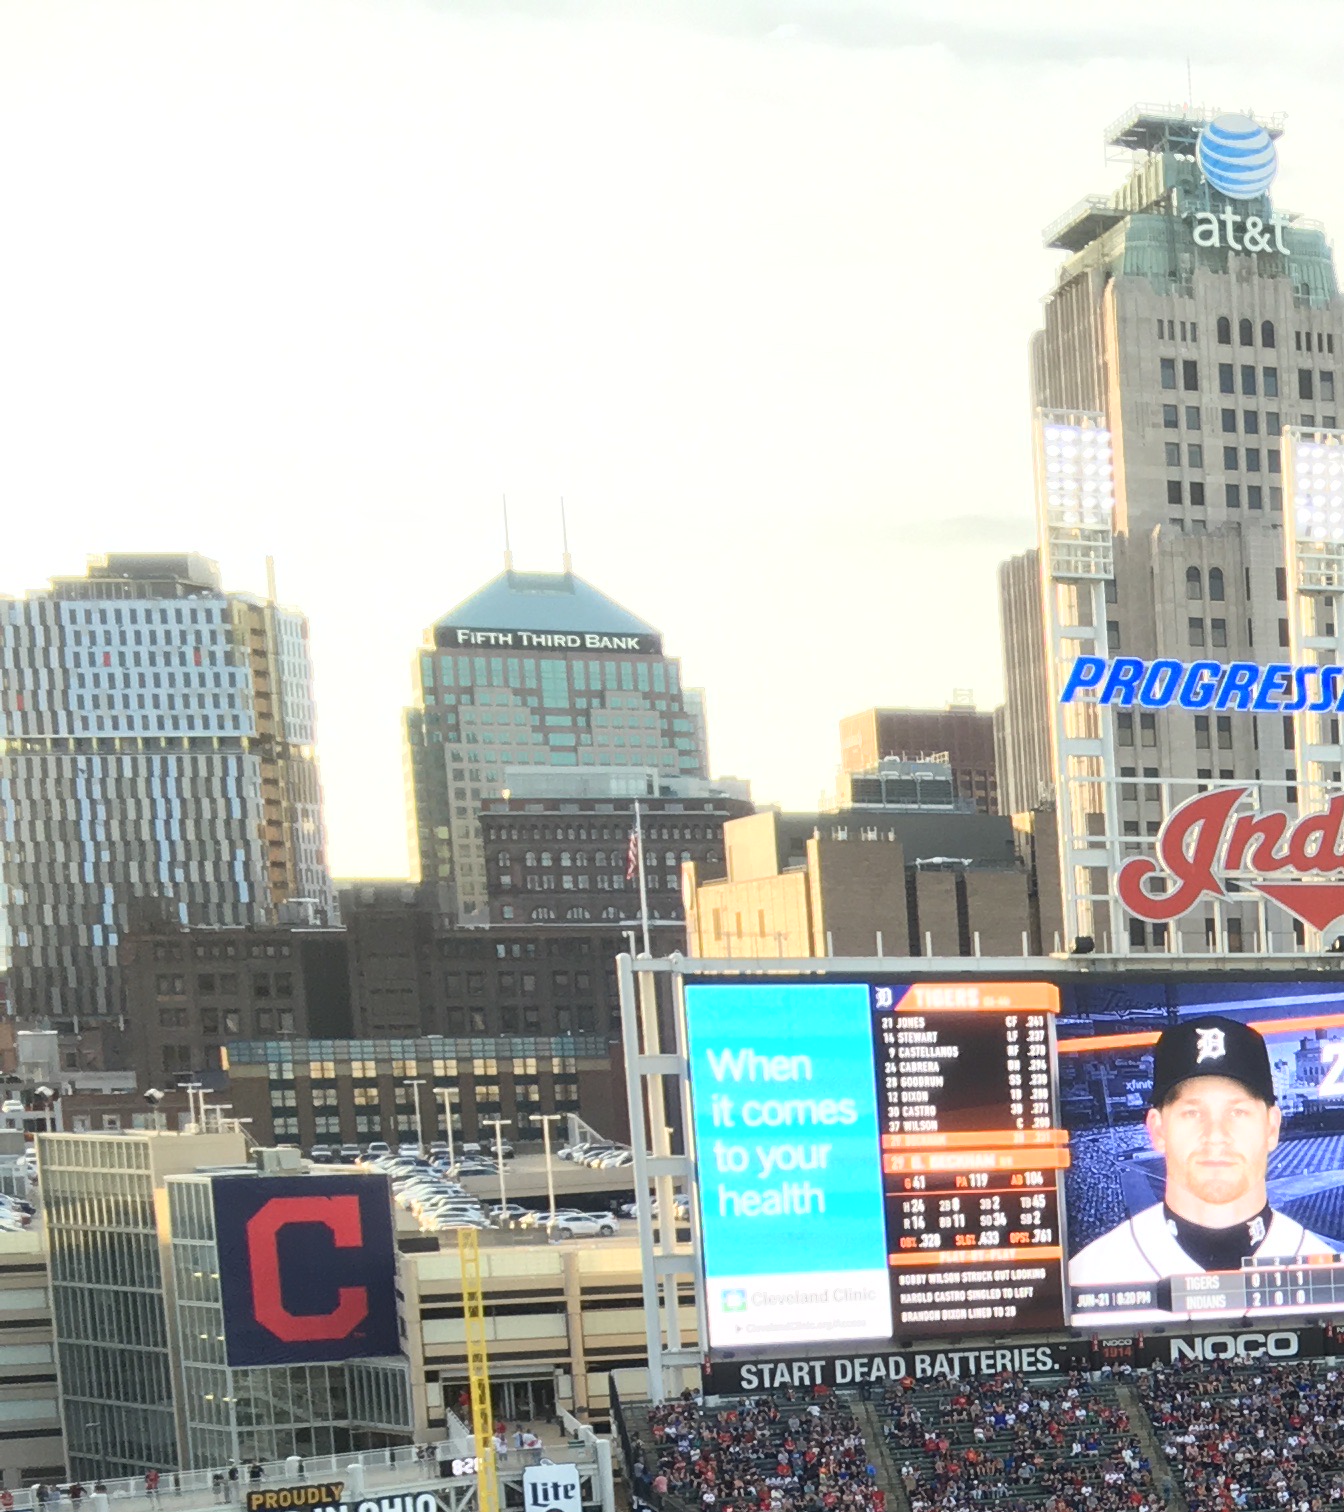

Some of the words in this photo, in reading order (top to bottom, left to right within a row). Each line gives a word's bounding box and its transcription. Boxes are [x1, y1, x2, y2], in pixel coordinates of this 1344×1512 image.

[1192, 206, 1290, 256] at&t
[455, 628, 514, 648] FIFTH
[517, 630, 581, 649] THIRD
[584, 633, 640, 651] BANK
[707, 1049, 812, 1082] When
[901, 1091, 928, 1103] DIXON
[713, 1097, 733, 1126] it
[743, 1099, 858, 1126] comes
[902, 1105, 936, 1117] CASTRO
[903, 1120, 938, 1132] WILSON
[714, 1143, 749, 1172] to
[757, 1142, 832, 1177] your
[719, 1183, 825, 1217] health
[246, 1194, 369, 1344] C
[1185, 1276, 1220, 1291] TIGERS
[1186, 1295, 1226, 1309] INDIANS
[1102, 1338, 1132, 1347] NOCO
[1103, 1339, 1133, 1348] NOCO
[1103, 1348, 1133, 1359] 1914
[1104, 1346, 1131, 1358] 1914
[1169, 1332, 1299, 1362] NOCO
[739, 1358, 824, 1391] START
[834, 1355, 906, 1384] DEAD
[915, 1345, 1060, 1378] BATTERIES.
[249, 1480, 346, 1511] PROUDLY
[528, 1481, 575, 1507] Lite
